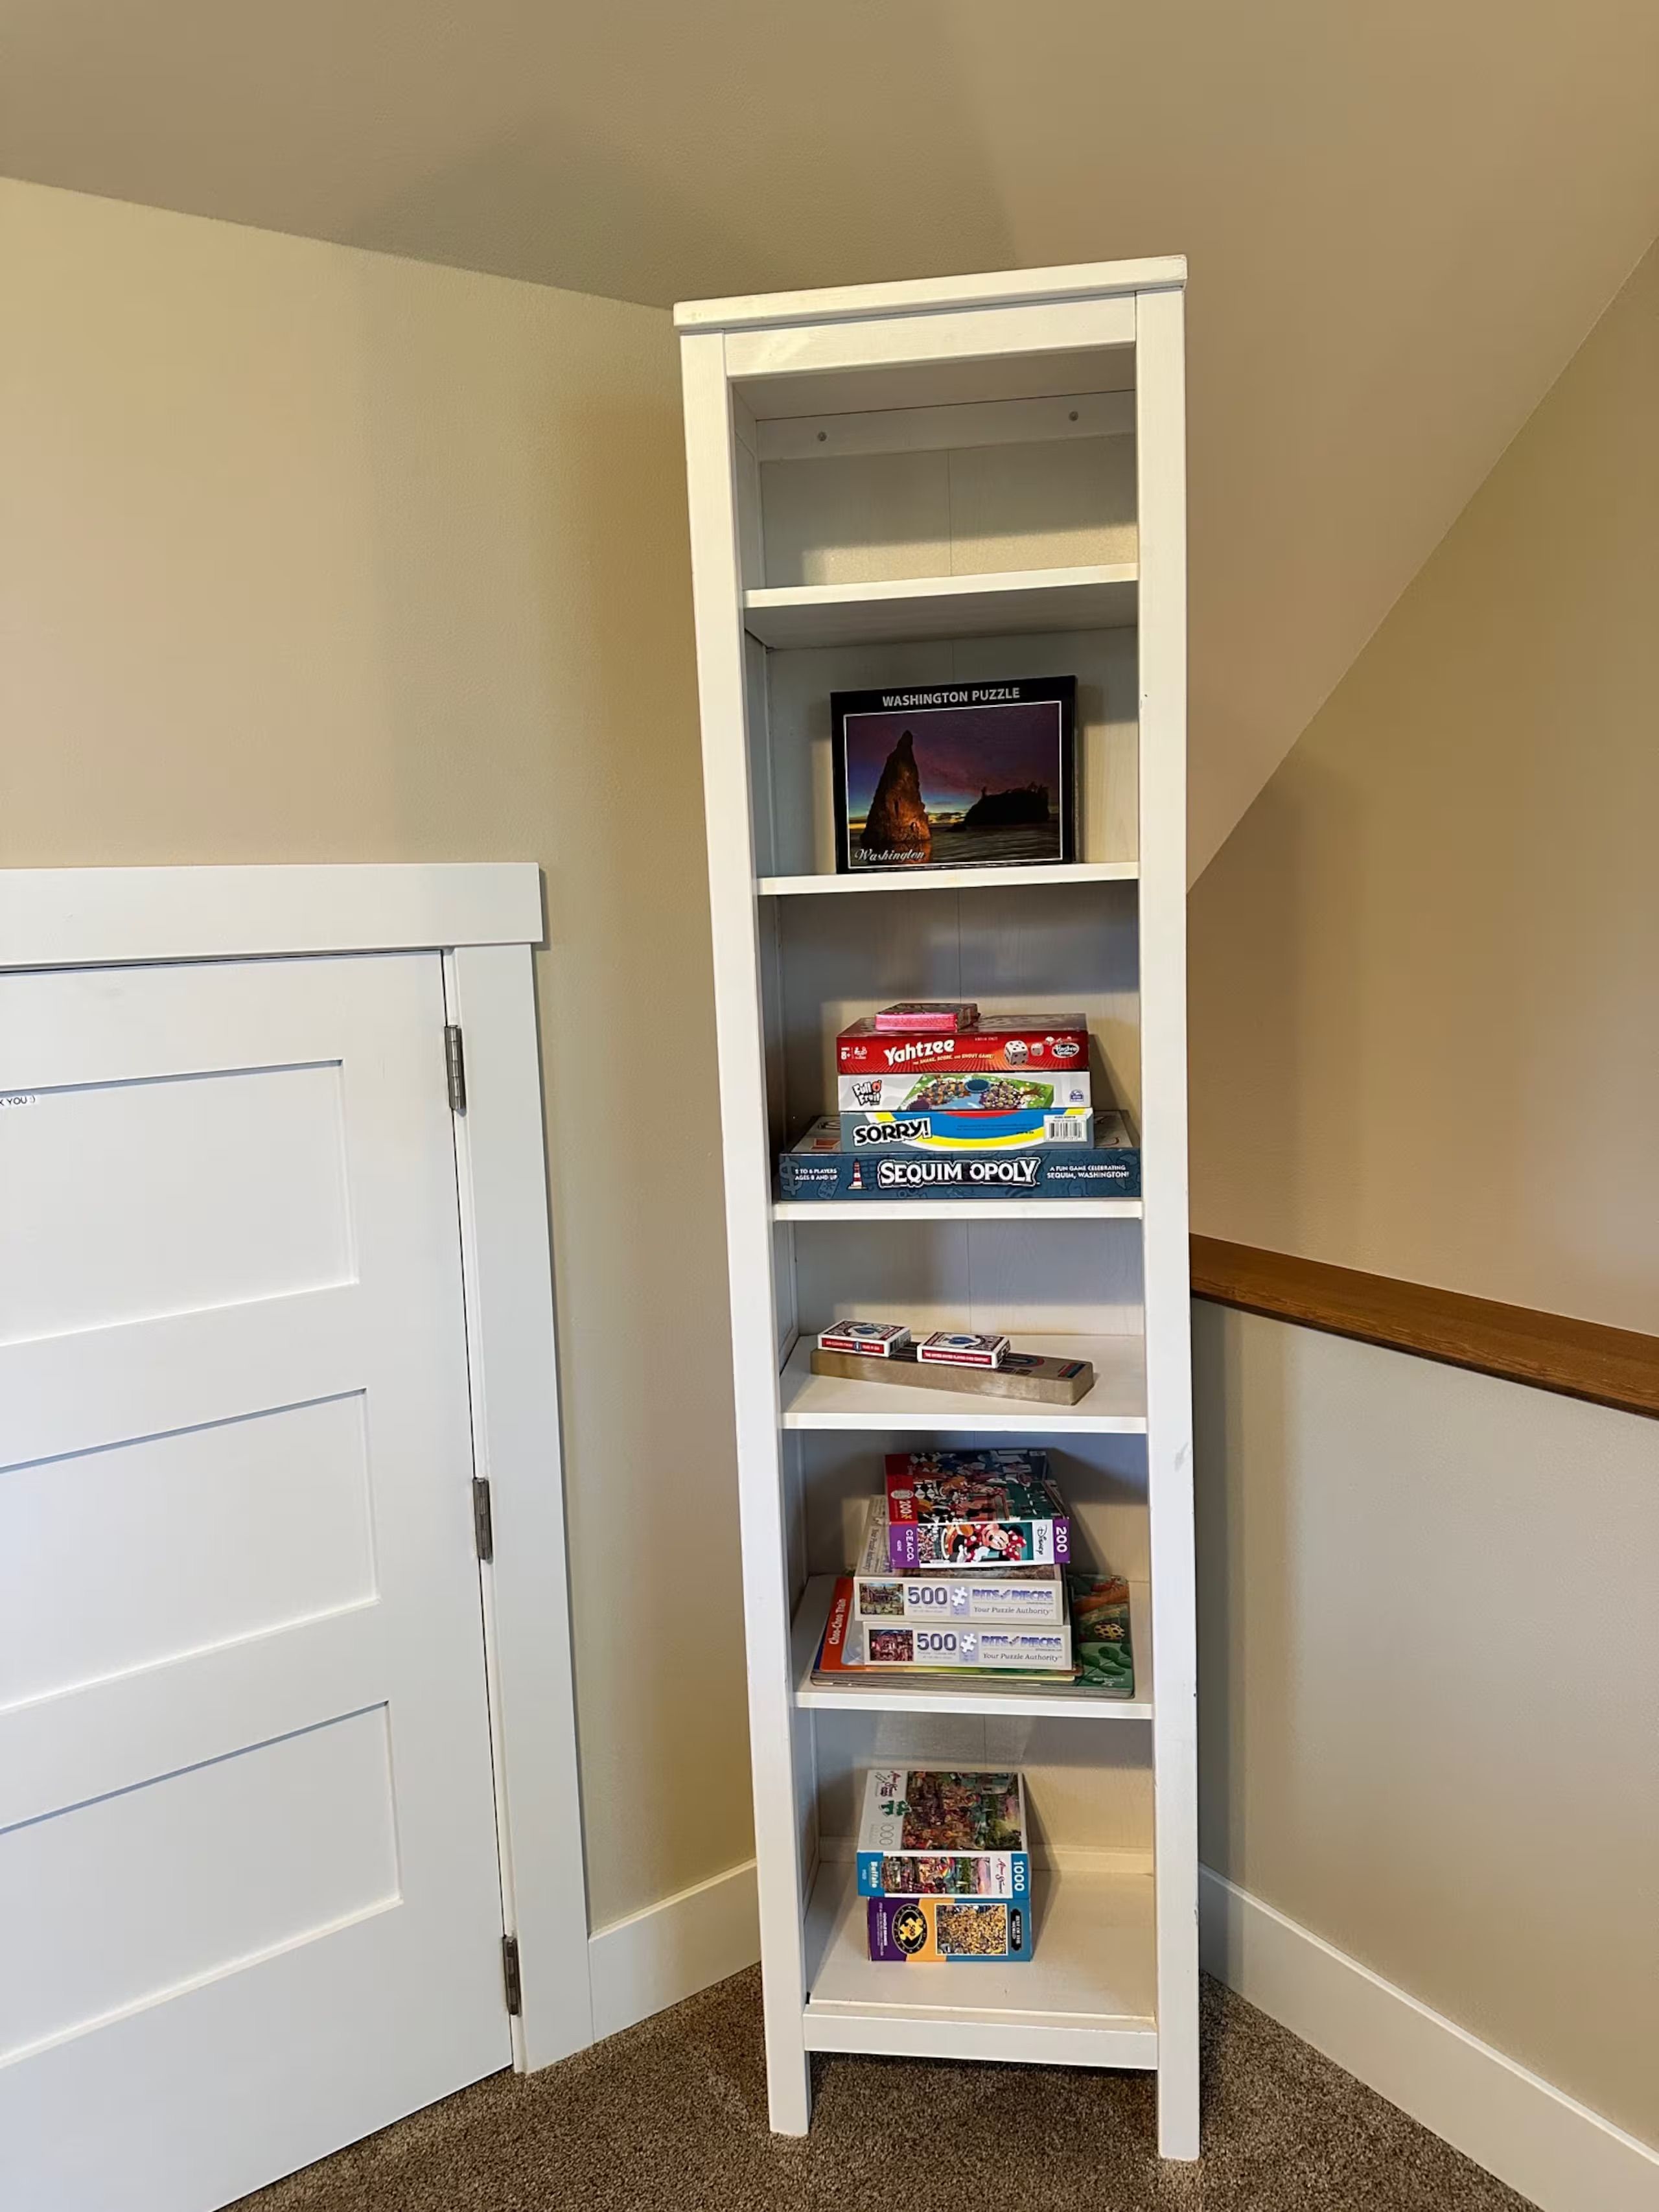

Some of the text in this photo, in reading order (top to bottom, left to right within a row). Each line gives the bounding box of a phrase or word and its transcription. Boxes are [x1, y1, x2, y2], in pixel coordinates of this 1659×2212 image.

[882, 688, 1020, 706] WASHINGTON PUZZLE
[854, 848, 924, 861] Washington
[883, 1039, 955, 1066] Yahtzee
[853, 1082, 872, 1095] Full
[854, 1120, 929, 1143] SORRY!
[881, 1160, 1038, 1183] SEQUIM OPOLY
[1036, 1524, 1048, 1555] Disney
[1056, 1526, 1068, 1553] 200
[908, 1587, 947, 1604] 500
[828, 1614, 844, 1644] Choo-Choo
[917, 1633, 957, 1651] 500
[870, 1861, 879, 1888] Buffalo
[1014, 1860, 1025, 1891] 1000
